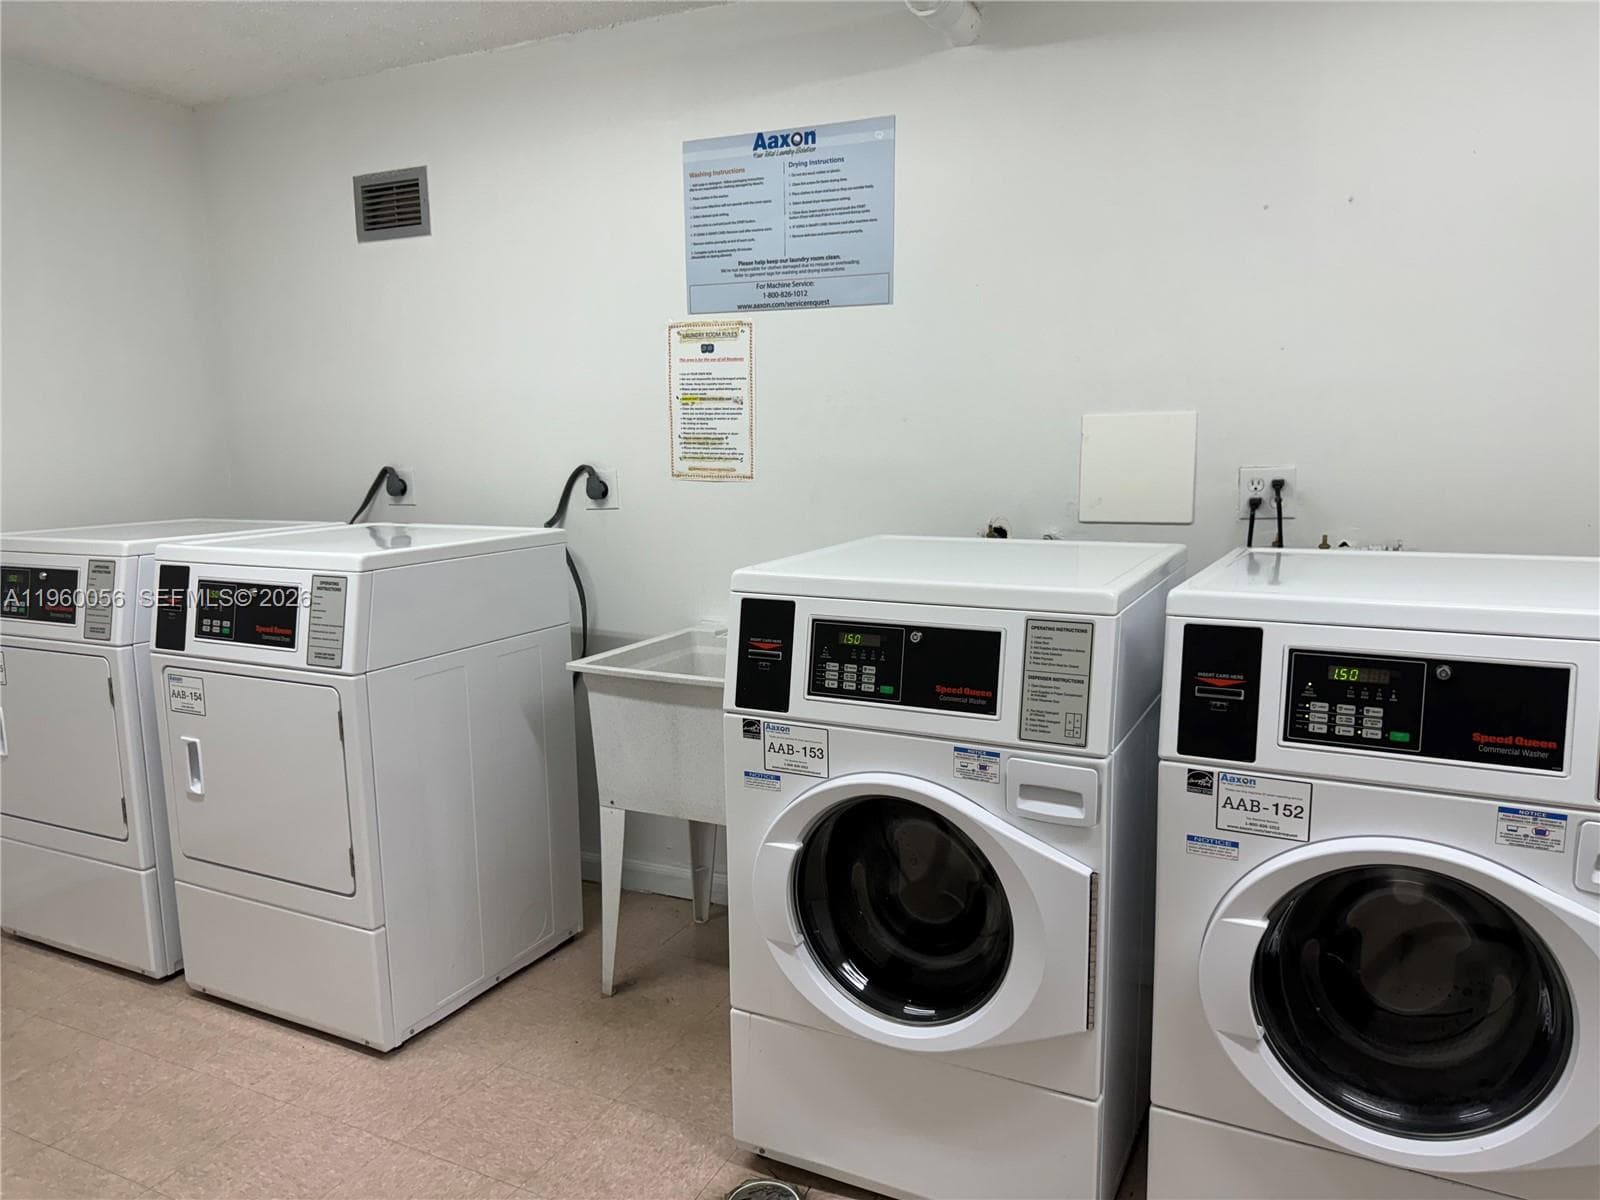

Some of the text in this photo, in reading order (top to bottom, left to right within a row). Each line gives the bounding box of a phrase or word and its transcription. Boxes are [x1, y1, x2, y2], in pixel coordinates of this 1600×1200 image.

[752, 129, 816, 151] Aaxon
[809, 157, 844, 166] Instructions
[689, 170, 712, 178] Washing
[754, 259, 766, 267] help
[766, 258, 778, 266] keep
[790, 256, 810, 264] laundry
[756, 280, 815, 290] For Machine Service:
[763, 290, 808, 298] 1-800-826-1012
[737, 299, 830, 310] www.aaxon.com/servicerequest
[171, 689, 202, 702] AAB-154
[936, 684, 992, 697] Speed Queen
[939, 695, 968, 704] Commercial
[766, 723, 790, 732] Aaxon
[1472, 732, 1558, 749] Speed Queen
[768, 742, 825, 760] AAB-153
[1478, 744, 1550, 758] Commercial Washer
[1220, 773, 1256, 786] Aaxon
[1221, 796, 1304, 820] AAB-152
[1519, 810, 1548, 818] NOTICE
[1194, 836, 1232, 847] NOTICE
